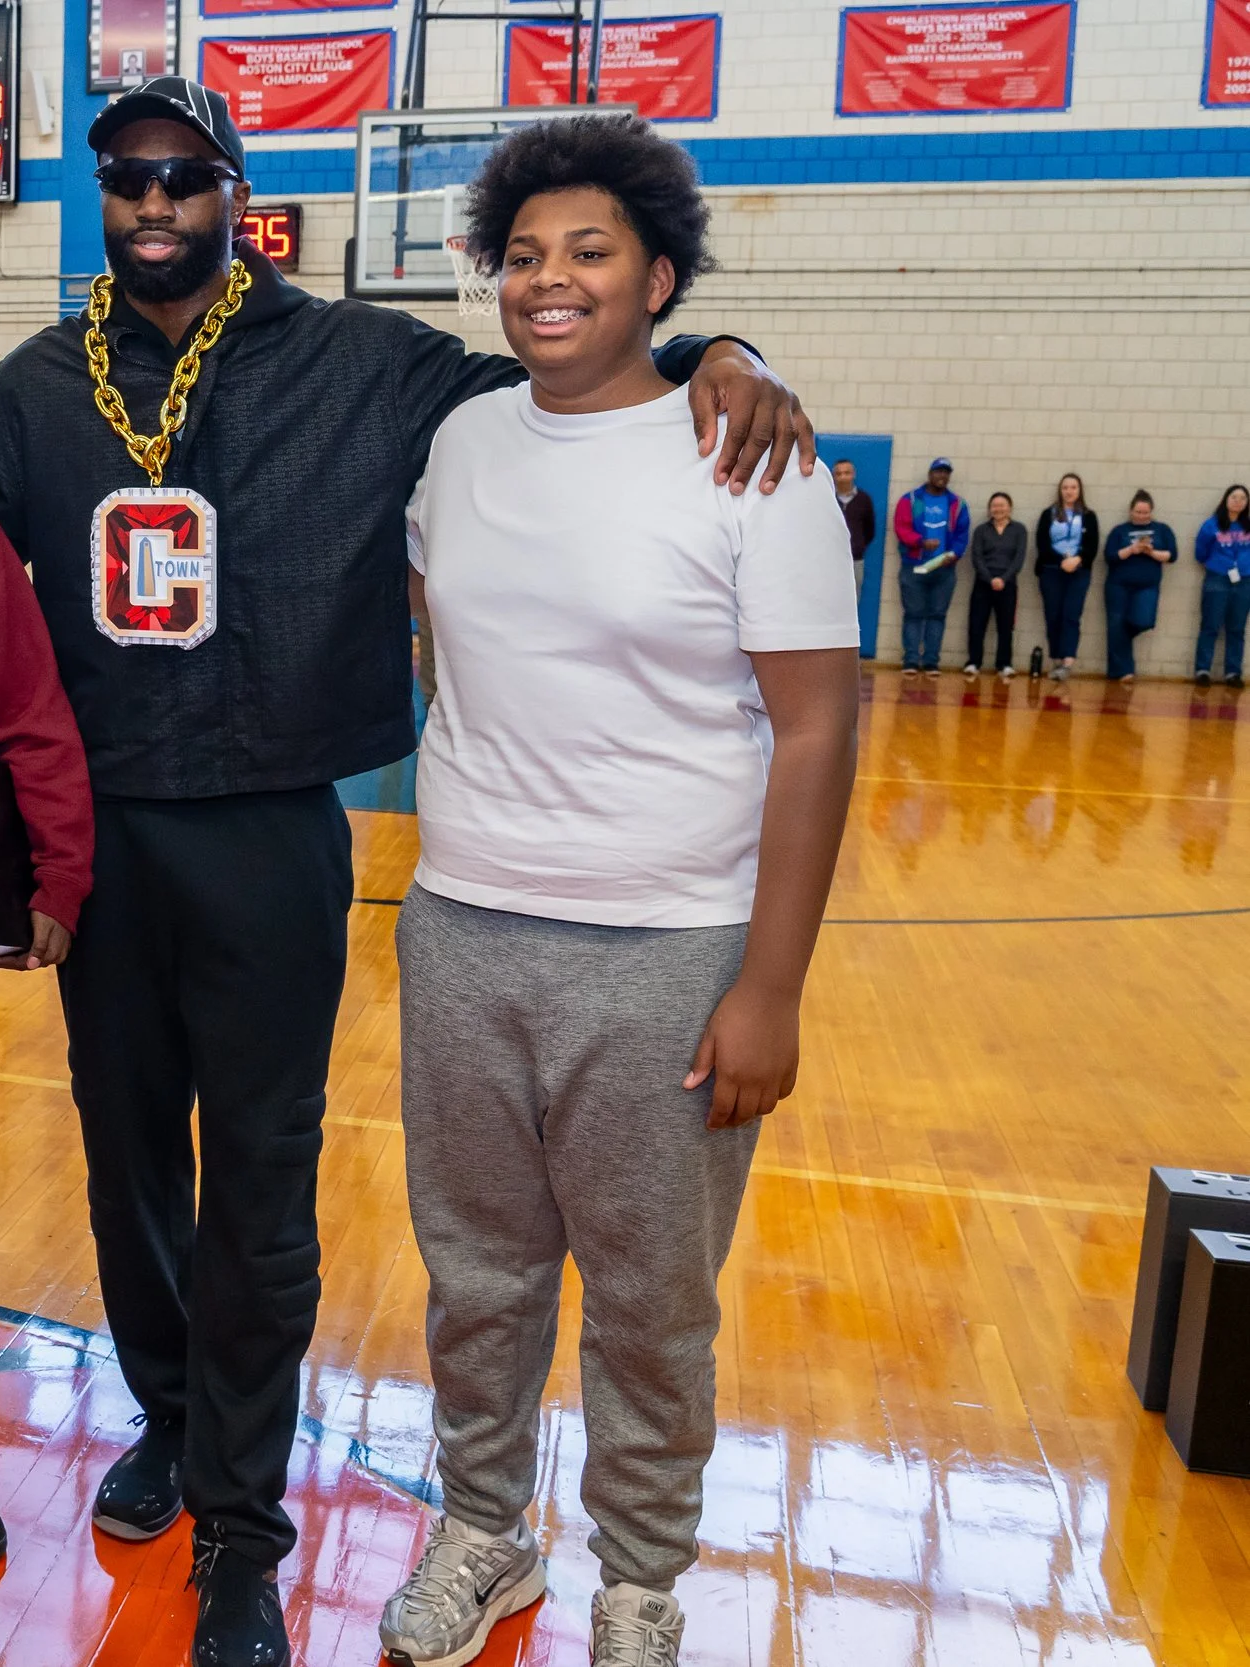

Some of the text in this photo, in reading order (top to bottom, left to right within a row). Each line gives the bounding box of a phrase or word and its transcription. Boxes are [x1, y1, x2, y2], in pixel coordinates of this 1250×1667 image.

[960, 13, 985, 22] HIGH
[987, 11, 1027, 20] SCHOOL
[905, 21, 1007, 34] BOYS BASKETBALL
[326, 39, 364, 49] SCHOOL
[907, 42, 1003, 53] STATE CHAMPIONS
[246, 50, 345, 64] BOYS BASKETBALL
[238, 63, 282, 75] BOSTON
[284, 62, 309, 73] CITY
[262, 73, 328, 86] CHAMPIONS
[244, 216, 289, 257] 35
[155, 560, 200, 578] TOWN
[646, 1600, 664, 1613] NIKE
